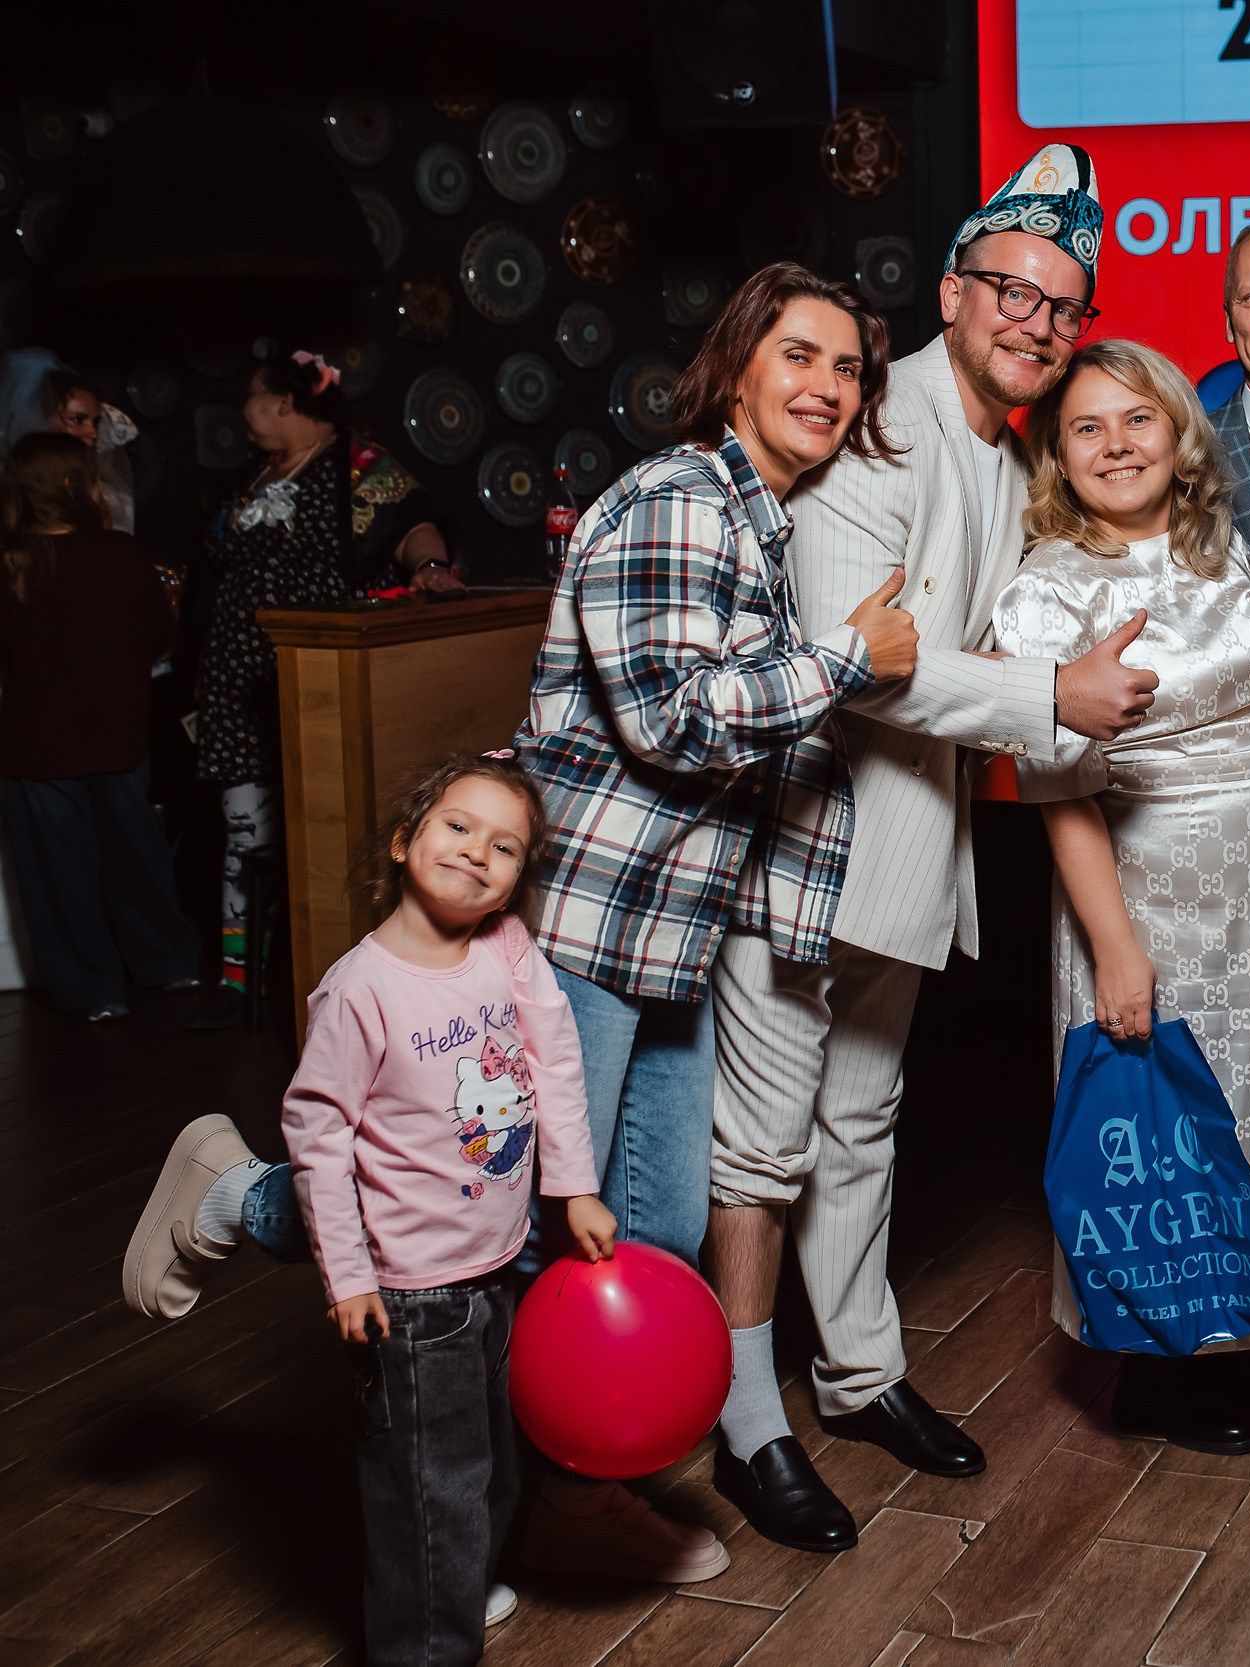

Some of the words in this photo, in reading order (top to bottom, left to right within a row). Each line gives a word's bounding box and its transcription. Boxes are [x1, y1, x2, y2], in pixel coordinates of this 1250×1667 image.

[411, 1015, 478, 1062] Hello
[1116, 1303, 1181, 1320] SYLED
[1187, 1297, 1204, 1314] IN
